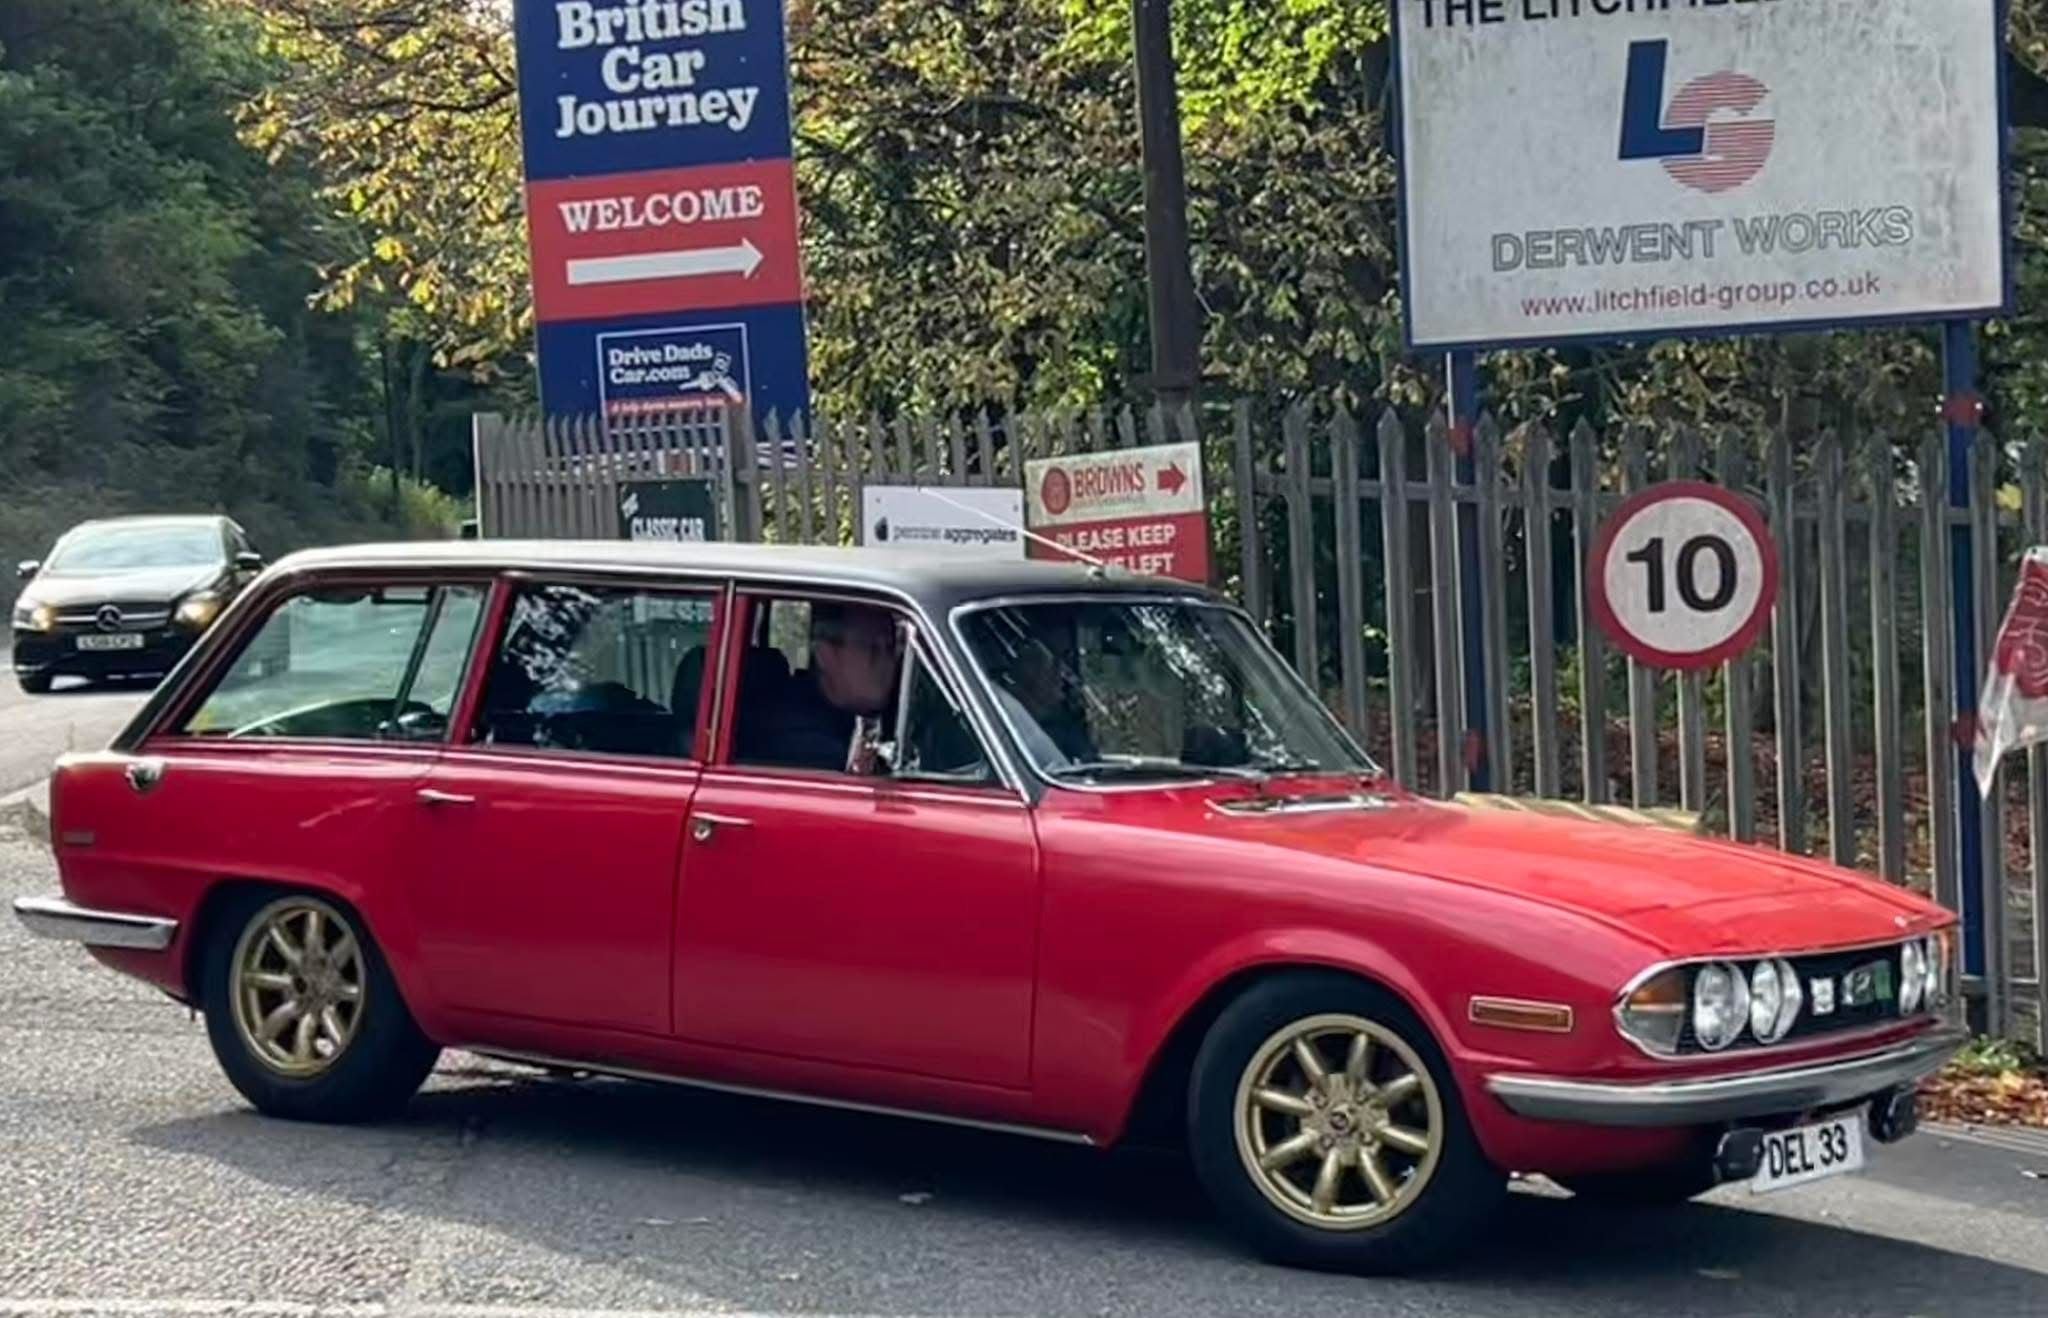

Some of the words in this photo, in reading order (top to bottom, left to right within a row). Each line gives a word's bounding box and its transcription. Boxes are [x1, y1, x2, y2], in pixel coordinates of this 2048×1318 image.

[556, 0, 746, 48] British
[1417, 0, 1505, 29] THE
[602, 46, 705, 93] Car
[556, 87, 759, 138] Journey
[558, 185, 765, 233] WELCOME
[1492, 219, 1722, 272] DERWENT
[1732, 205, 1914, 255] WORKS
[1520, 272, 1881, 318] www.litchfield-group.co.uk
[608, 345, 662, 366] Drive
[664, 342, 713, 362] Dads
[610, 365, 690, 384] Car.com
[1073, 461, 1145, 498] BROWNS
[1056, 527, 1124, 551] PLEASE
[1127, 524, 1176, 548] KEEP
[1129, 552, 1174, 575] LEFT
[1627, 533, 1739, 613] 10
[1768, 1132, 1815, 1178] DEL
[1819, 1123, 1848, 1167] 33
